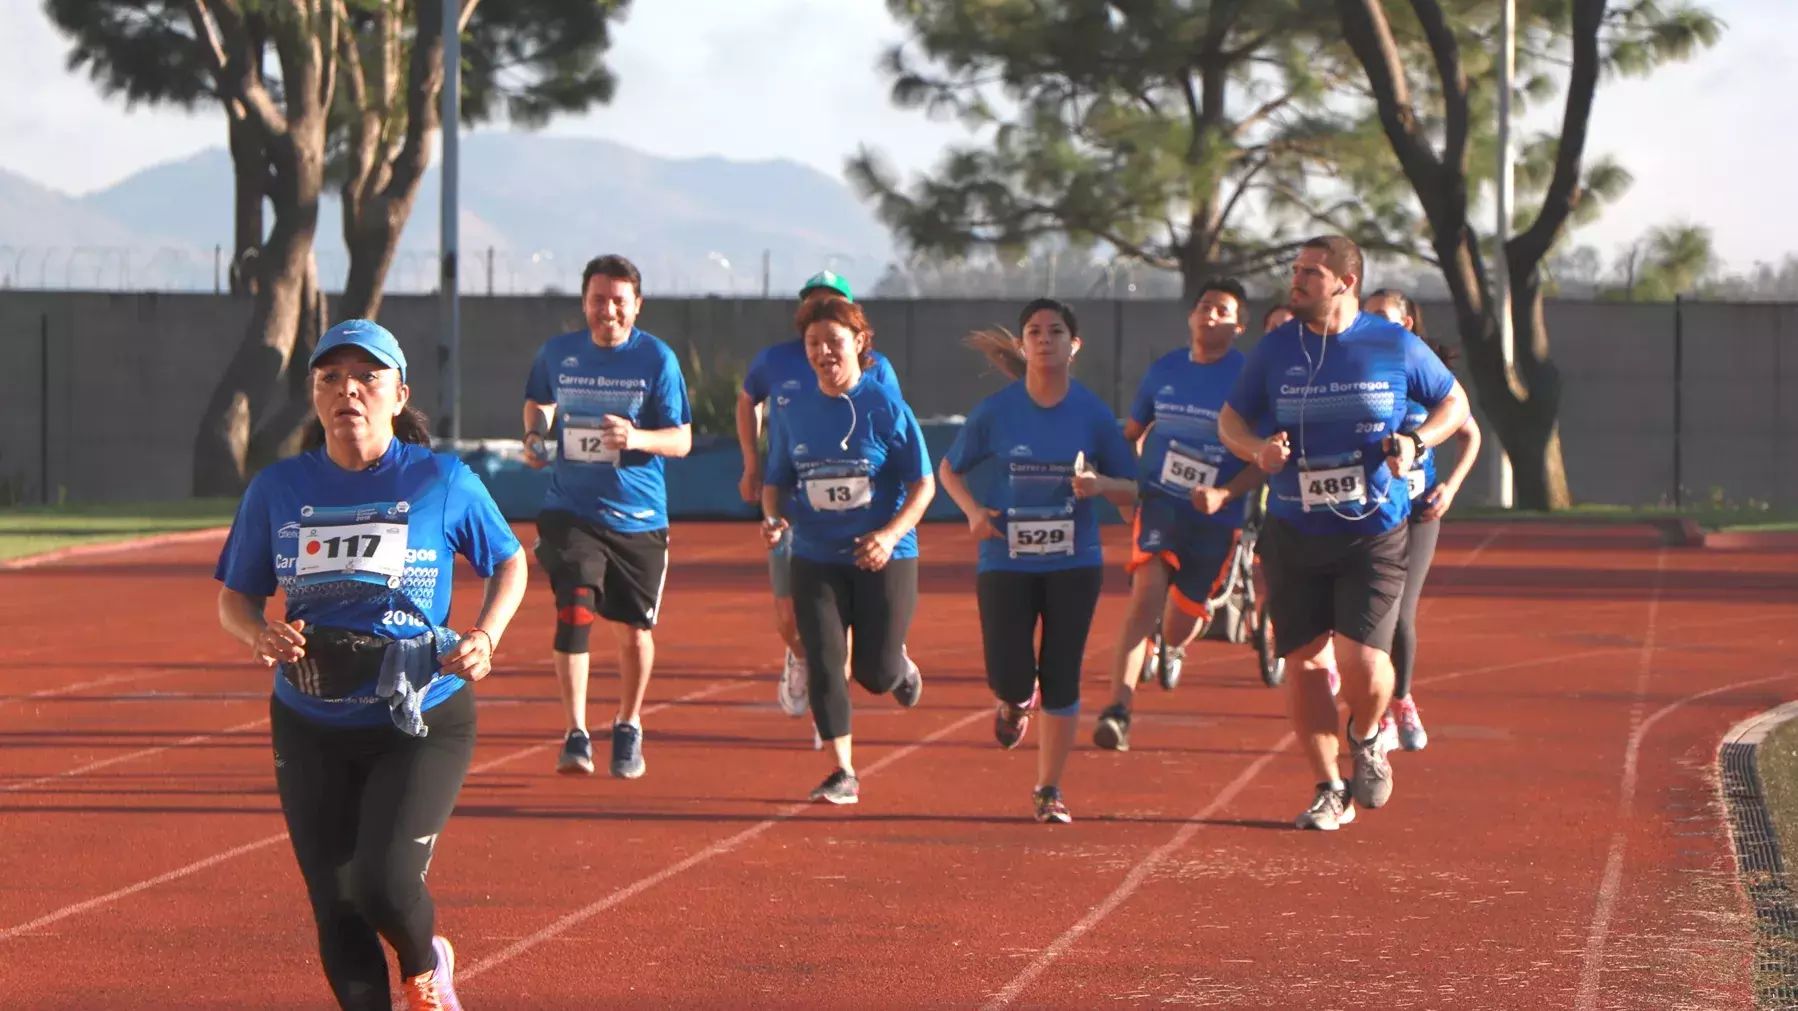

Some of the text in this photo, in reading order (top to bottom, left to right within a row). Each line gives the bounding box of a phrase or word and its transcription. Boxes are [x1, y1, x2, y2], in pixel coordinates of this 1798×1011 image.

[559, 373, 646, 389] Carrera Borregos
[1280, 380, 1390, 395] Carrera Borregos
[1355, 421, 1386, 433] 2018
[578, 437, 601, 453] 12
[1171, 461, 1208, 485] 561
[825, 485, 852, 503] 13
[1308, 475, 1357, 496] 489
[1017, 529, 1065, 546] 529
[323, 535, 382, 559] 117
[404, 548, 438, 563] gos
[381, 609, 425, 627] 2018
